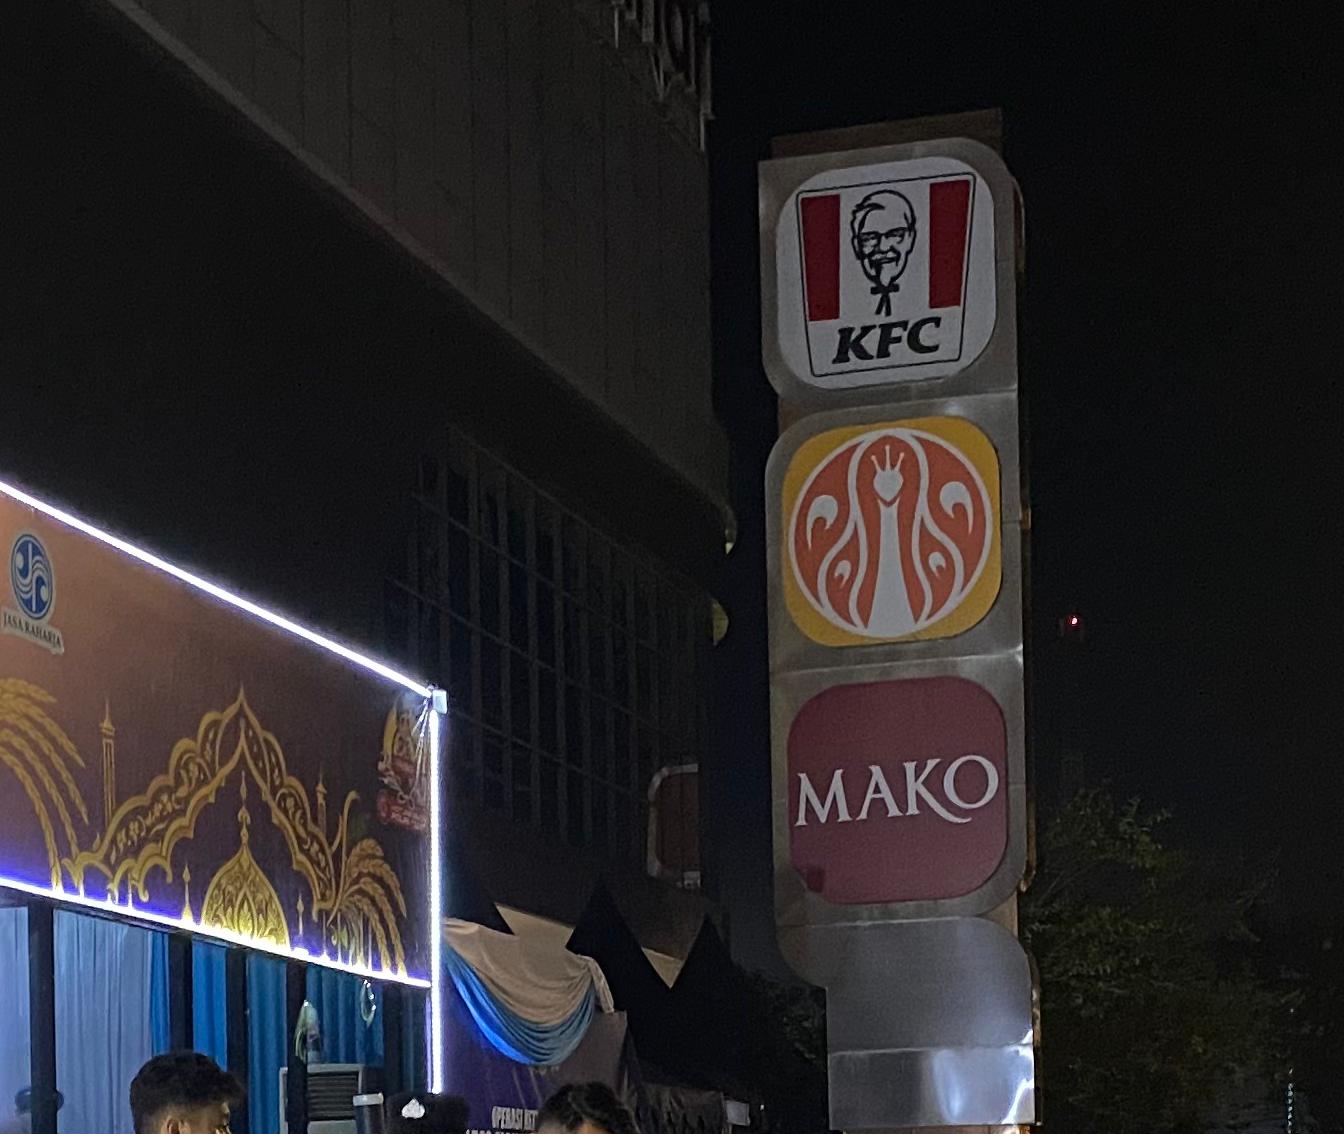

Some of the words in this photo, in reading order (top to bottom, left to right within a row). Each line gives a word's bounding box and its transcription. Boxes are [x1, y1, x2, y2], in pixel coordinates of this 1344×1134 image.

[832, 316, 942, 364] KFC
[794, 755, 999, 826] MAKO
[491, 1105, 524, 1131] OPERASI
